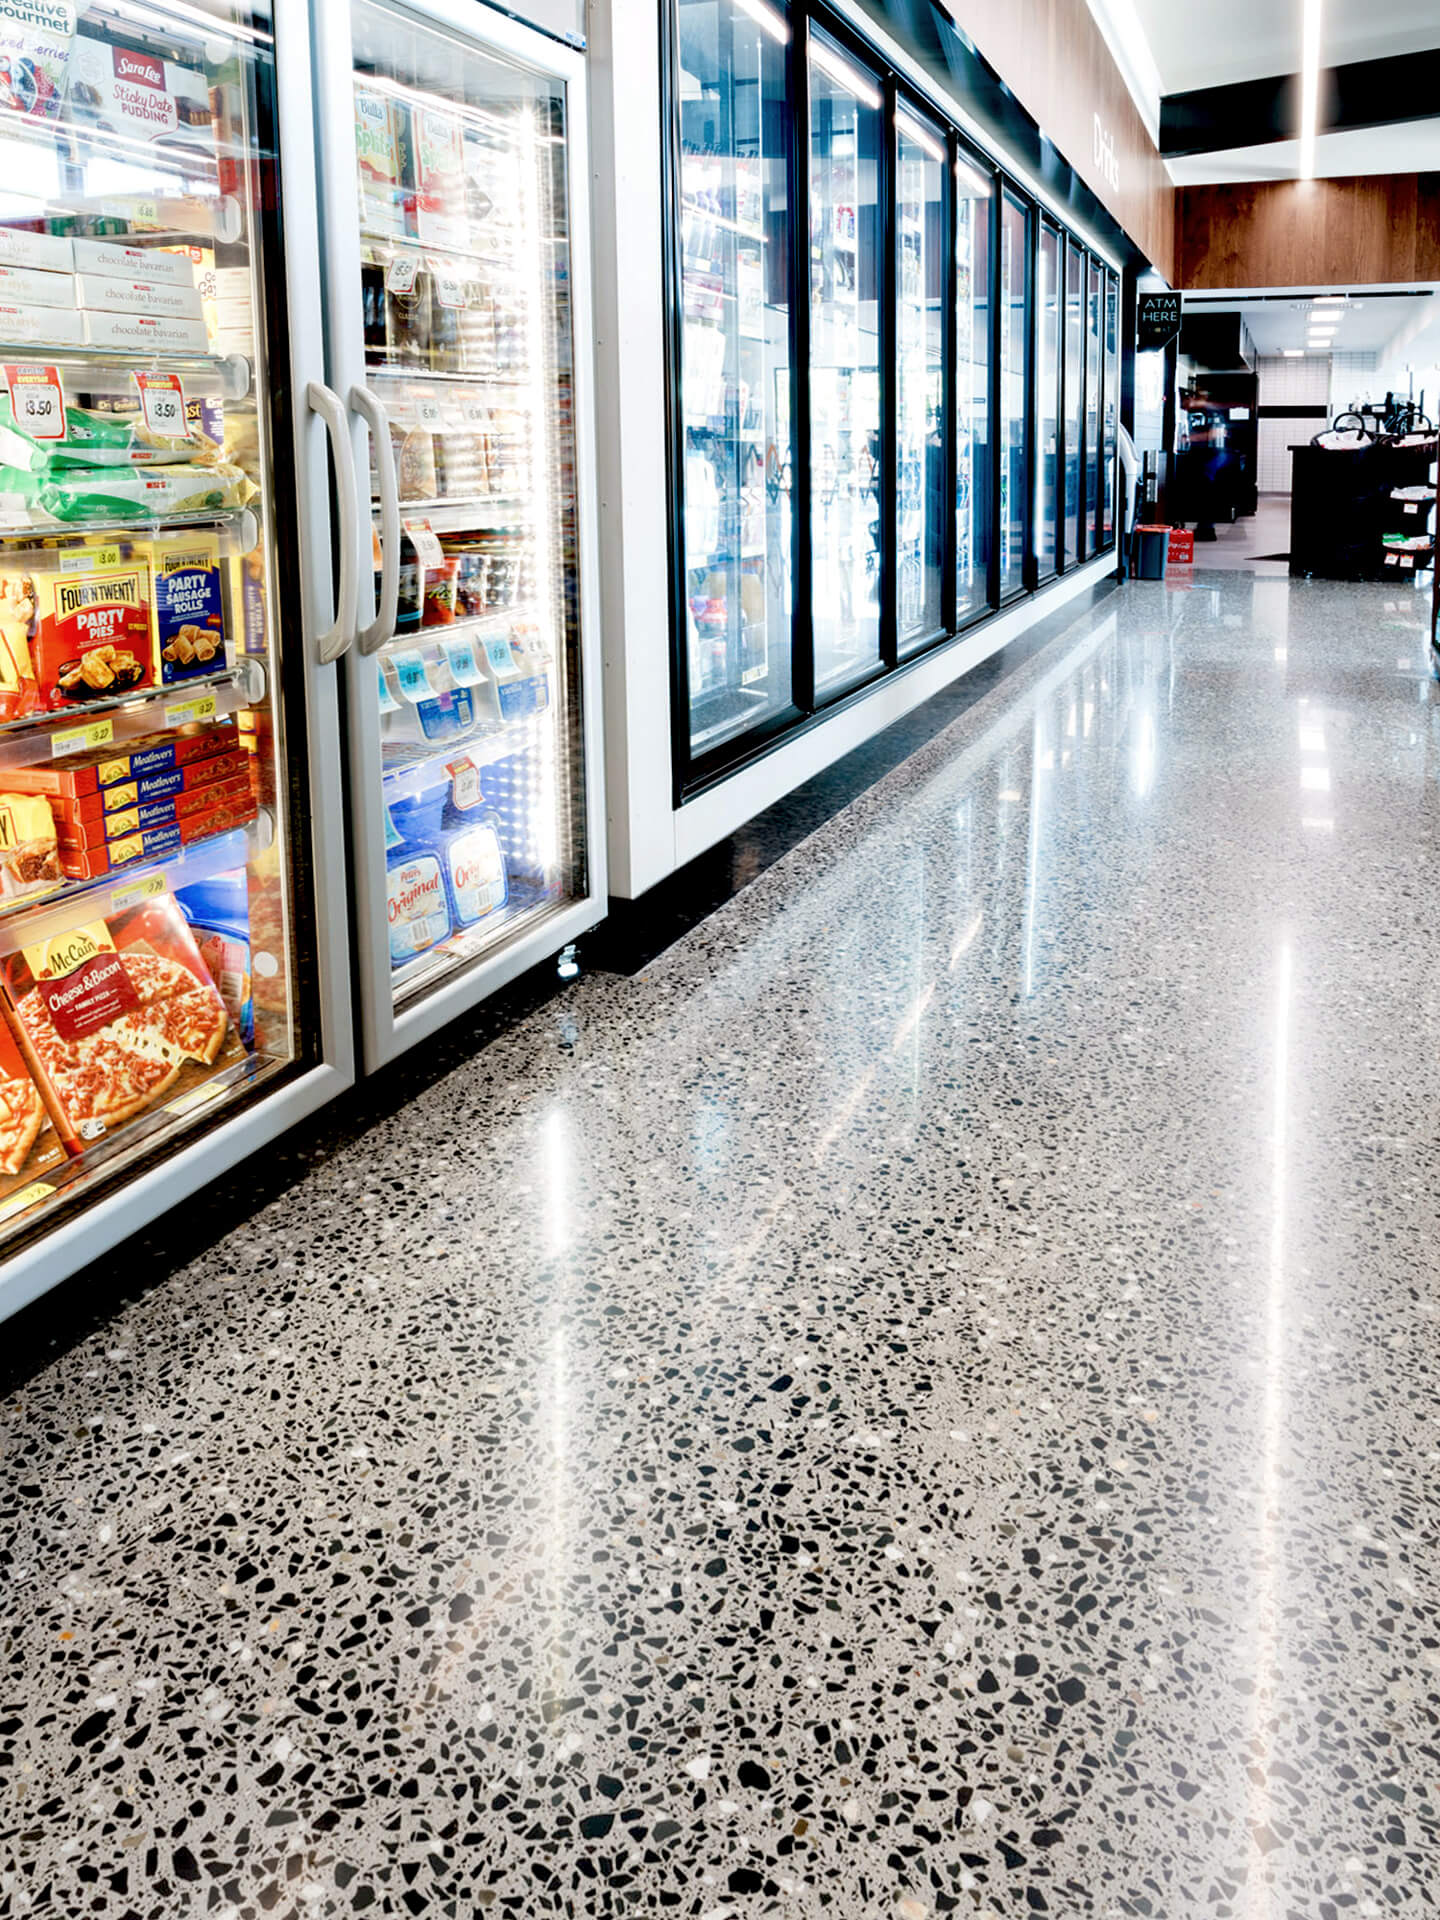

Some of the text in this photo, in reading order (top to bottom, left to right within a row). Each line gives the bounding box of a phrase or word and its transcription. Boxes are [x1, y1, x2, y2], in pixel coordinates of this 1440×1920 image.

[0, 7, 69, 33] ourmet
[34, 45, 70, 62] erries
[118, 57, 161, 84] Sara Lee
[113, 83, 173, 113] Sticky Date
[121, 102, 168, 124] PUDDING
[360, 98, 383, 120] Bulla
[1094, 112, 1119, 193] Drinks
[97, 253, 138, 269] chocolate
[139, 258, 174, 273] bavarian
[105, 287, 146, 302] chocolate
[147, 292, 184, 307] bavarian
[1144, 298, 1177, 309] ATM
[1142, 311, 1178, 322] HERE
[111, 322, 151, 337] chocolate
[153, 328, 189, 340] bavarian
[98, 578, 136, 603] TWENTY
[168, 574, 207, 593] PARTY
[166, 587, 212, 605] SAUSAGE
[174, 599, 204, 614] ROLLS
[77, 607, 124, 631] PARTY
[89, 625, 115, 640] PIES
[133, 749, 174, 768] Meatlovers
[141, 773, 182, 793] Meatlovers
[387, 871, 439, 923] Original
[50, 941, 97, 974] McCain
